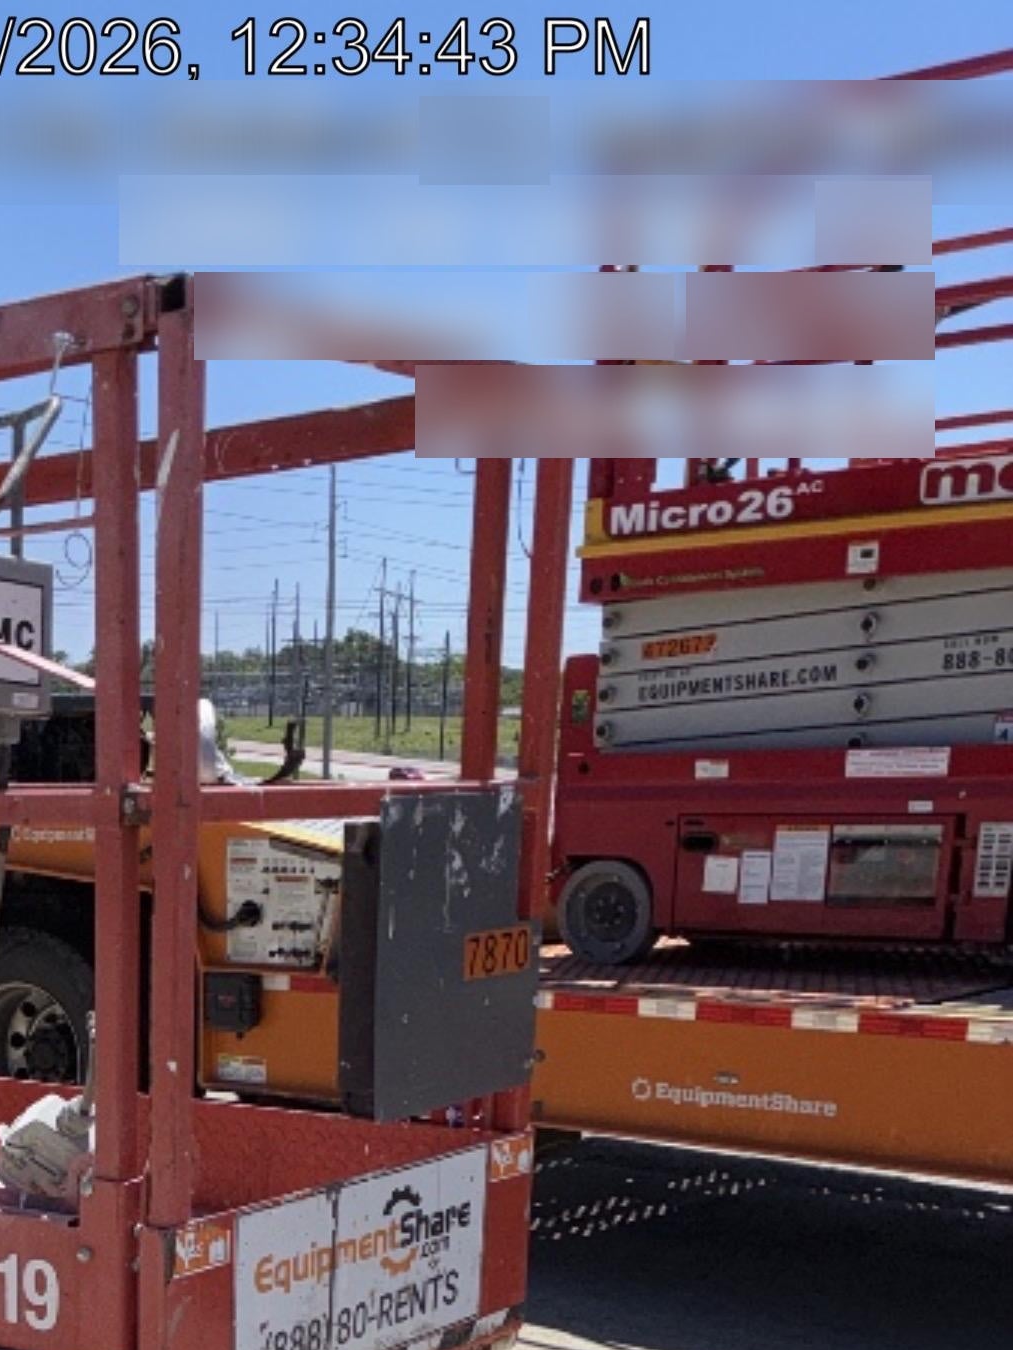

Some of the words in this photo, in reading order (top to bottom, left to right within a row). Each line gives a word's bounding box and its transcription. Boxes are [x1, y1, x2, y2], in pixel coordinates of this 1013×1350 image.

[637, 665, 838, 702] EQUIPMENTSHARE.COM
[467, 929, 530, 976] 7870
[655, 1080, 838, 1117] EquipmentShare
[253, 1200, 472, 1294] EquipmentShare
